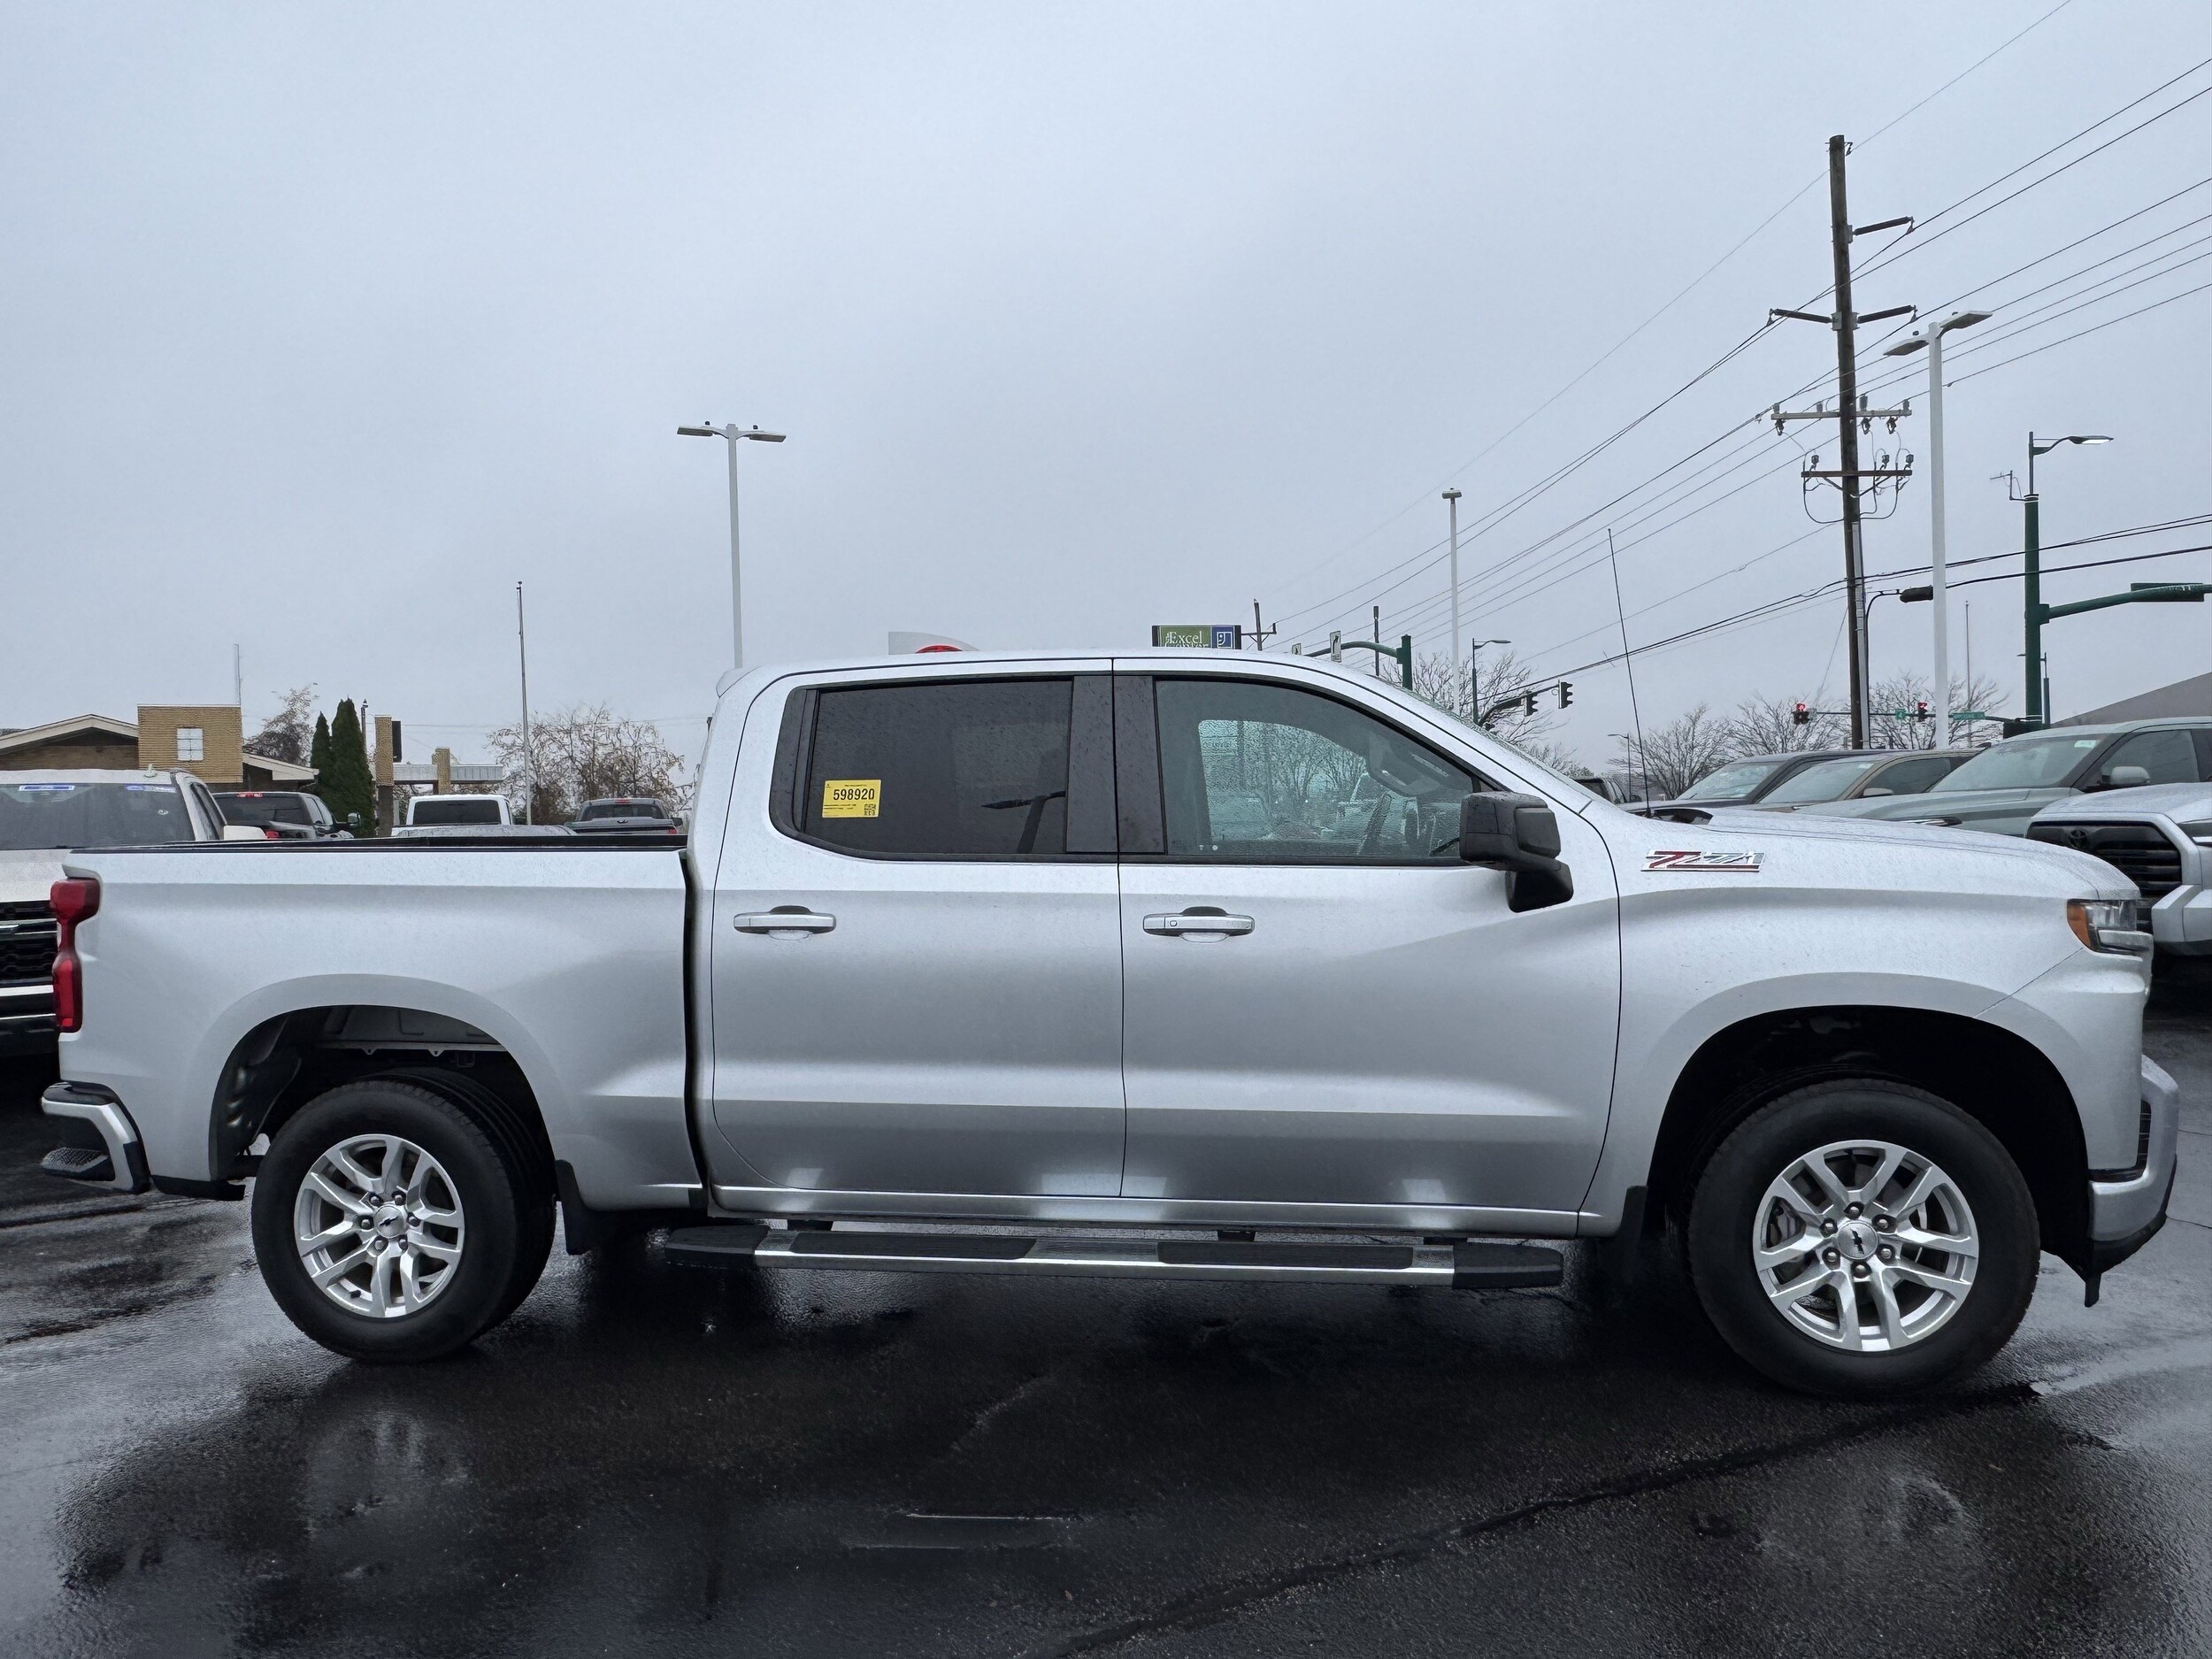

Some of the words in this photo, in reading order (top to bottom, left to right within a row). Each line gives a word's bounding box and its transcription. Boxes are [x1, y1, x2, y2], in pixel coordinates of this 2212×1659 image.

[1169, 631, 1202, 644] Excel
[833, 788, 875, 801] 598920
[1641, 850, 1765, 872] Z71
